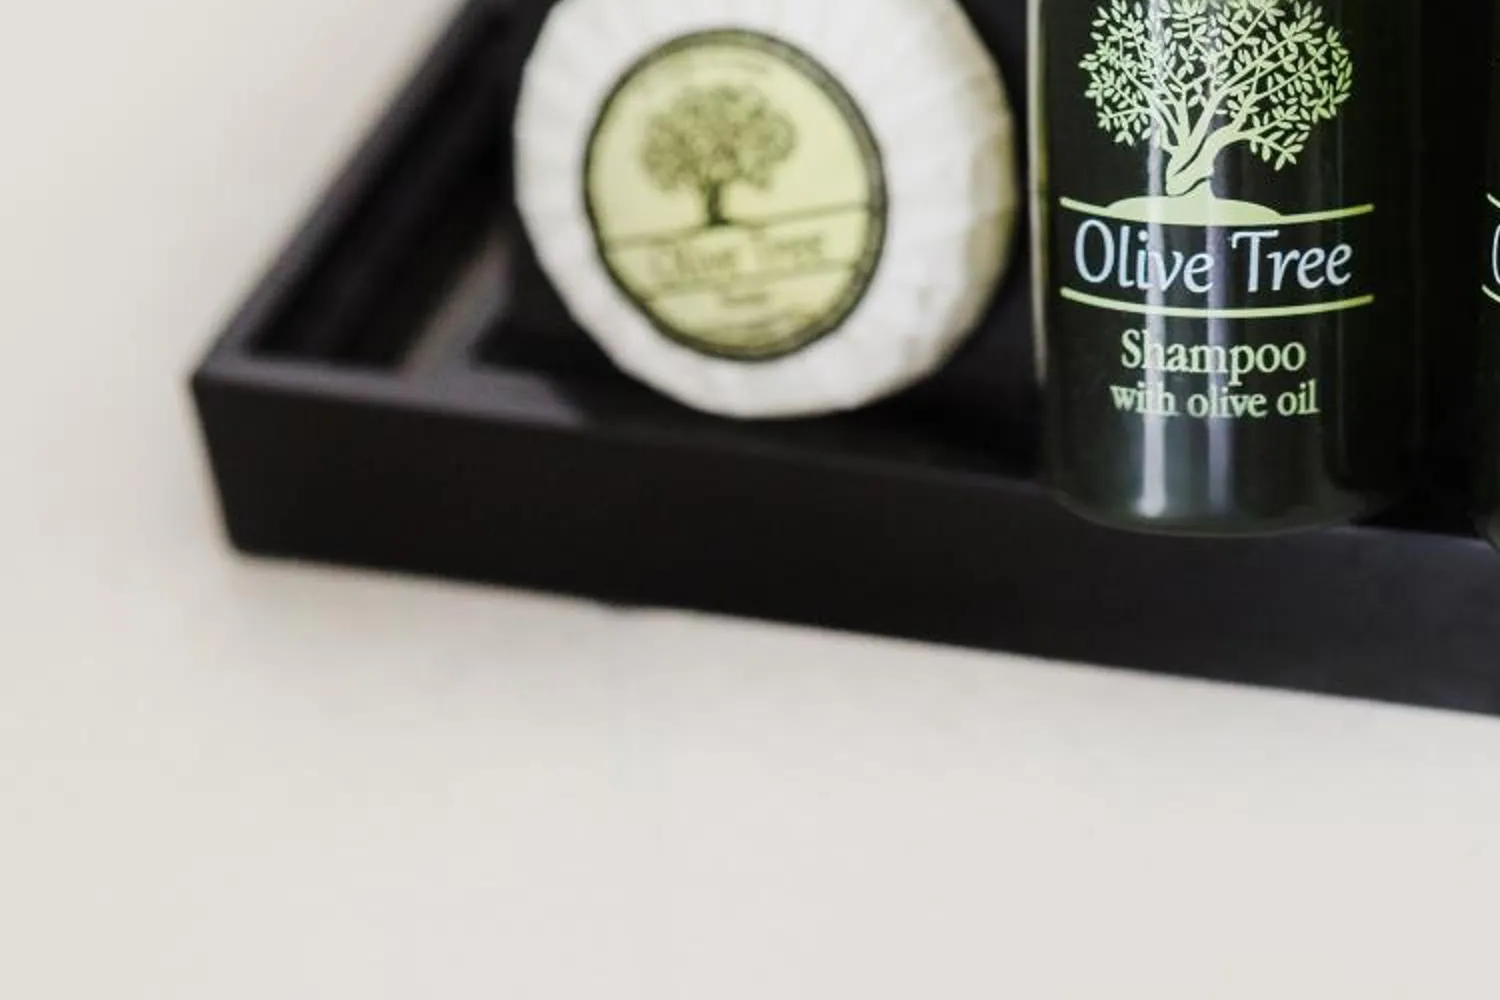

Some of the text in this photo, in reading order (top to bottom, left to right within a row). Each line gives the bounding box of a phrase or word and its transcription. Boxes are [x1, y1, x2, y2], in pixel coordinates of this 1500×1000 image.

[1074, 218, 1353, 294] Olive Tree
[1121, 328, 1307, 387] Shampoo
[1109, 378, 1320, 418] with olive oil
